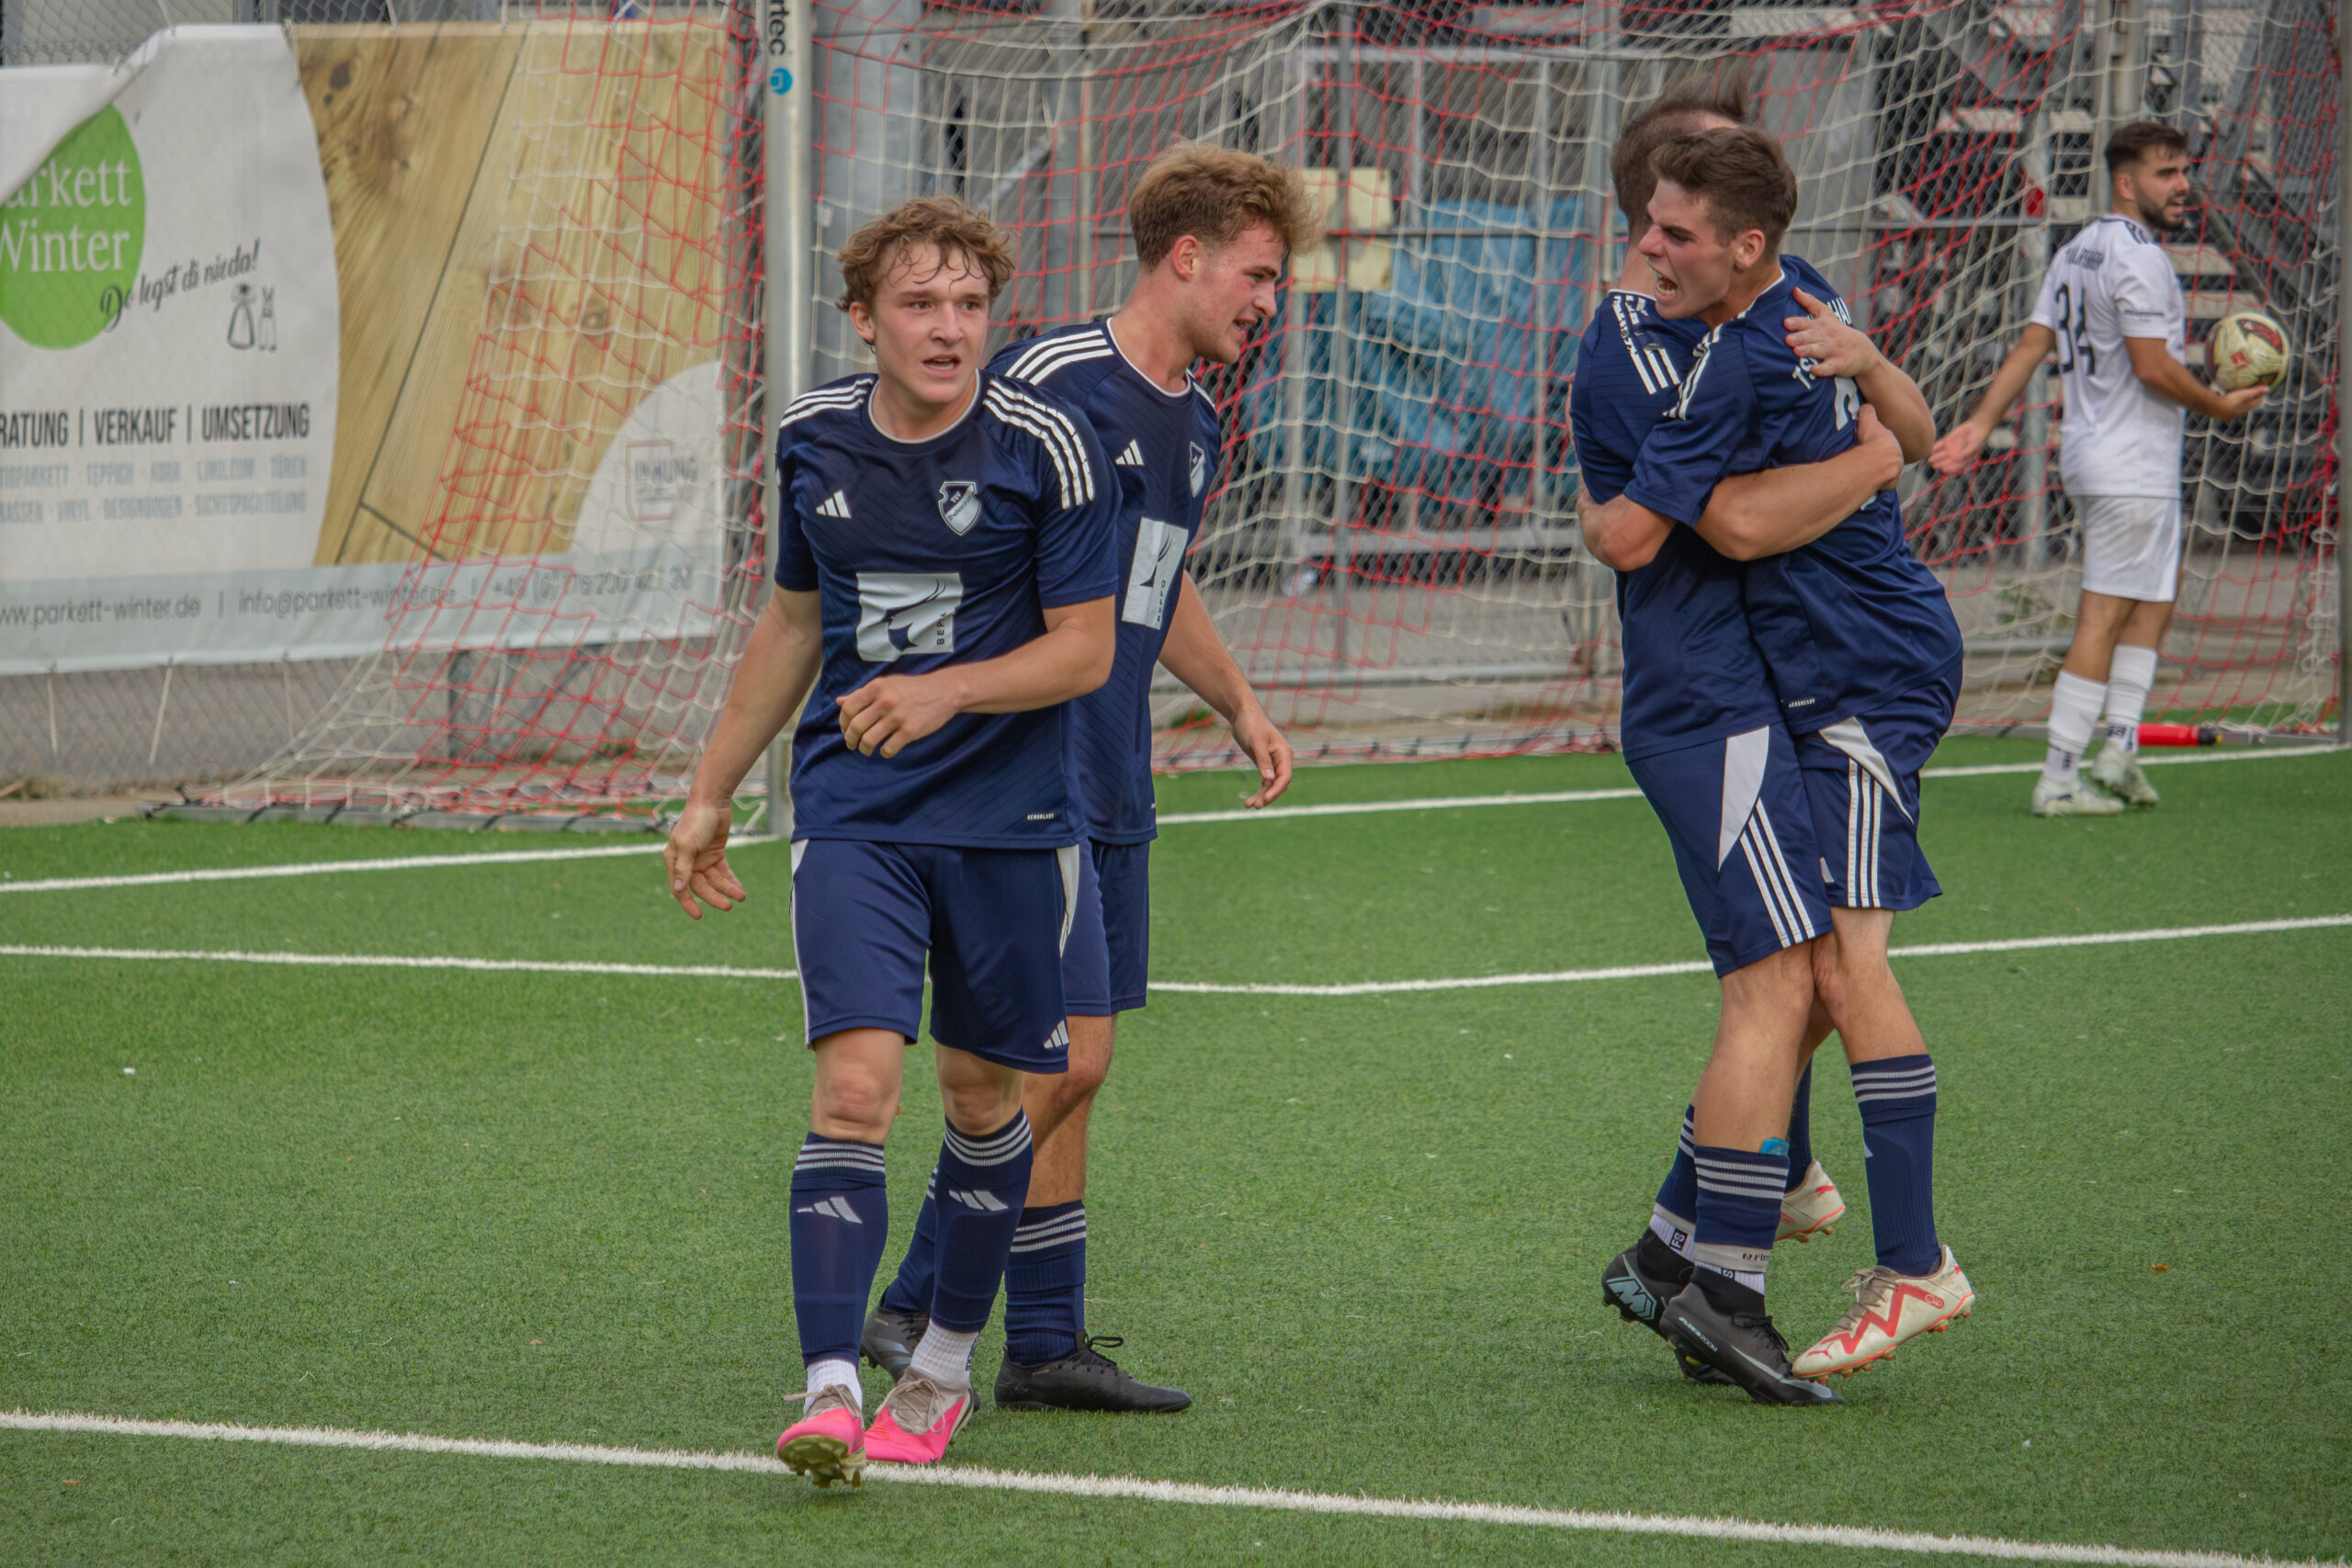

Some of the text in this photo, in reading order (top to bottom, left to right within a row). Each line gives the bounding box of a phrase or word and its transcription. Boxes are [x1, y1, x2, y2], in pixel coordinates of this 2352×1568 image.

[94, 408, 177, 446] VERKAUF
[201, 402, 311, 442] UMSETZUNG
[1670, 1232, 1687, 1249] FS
